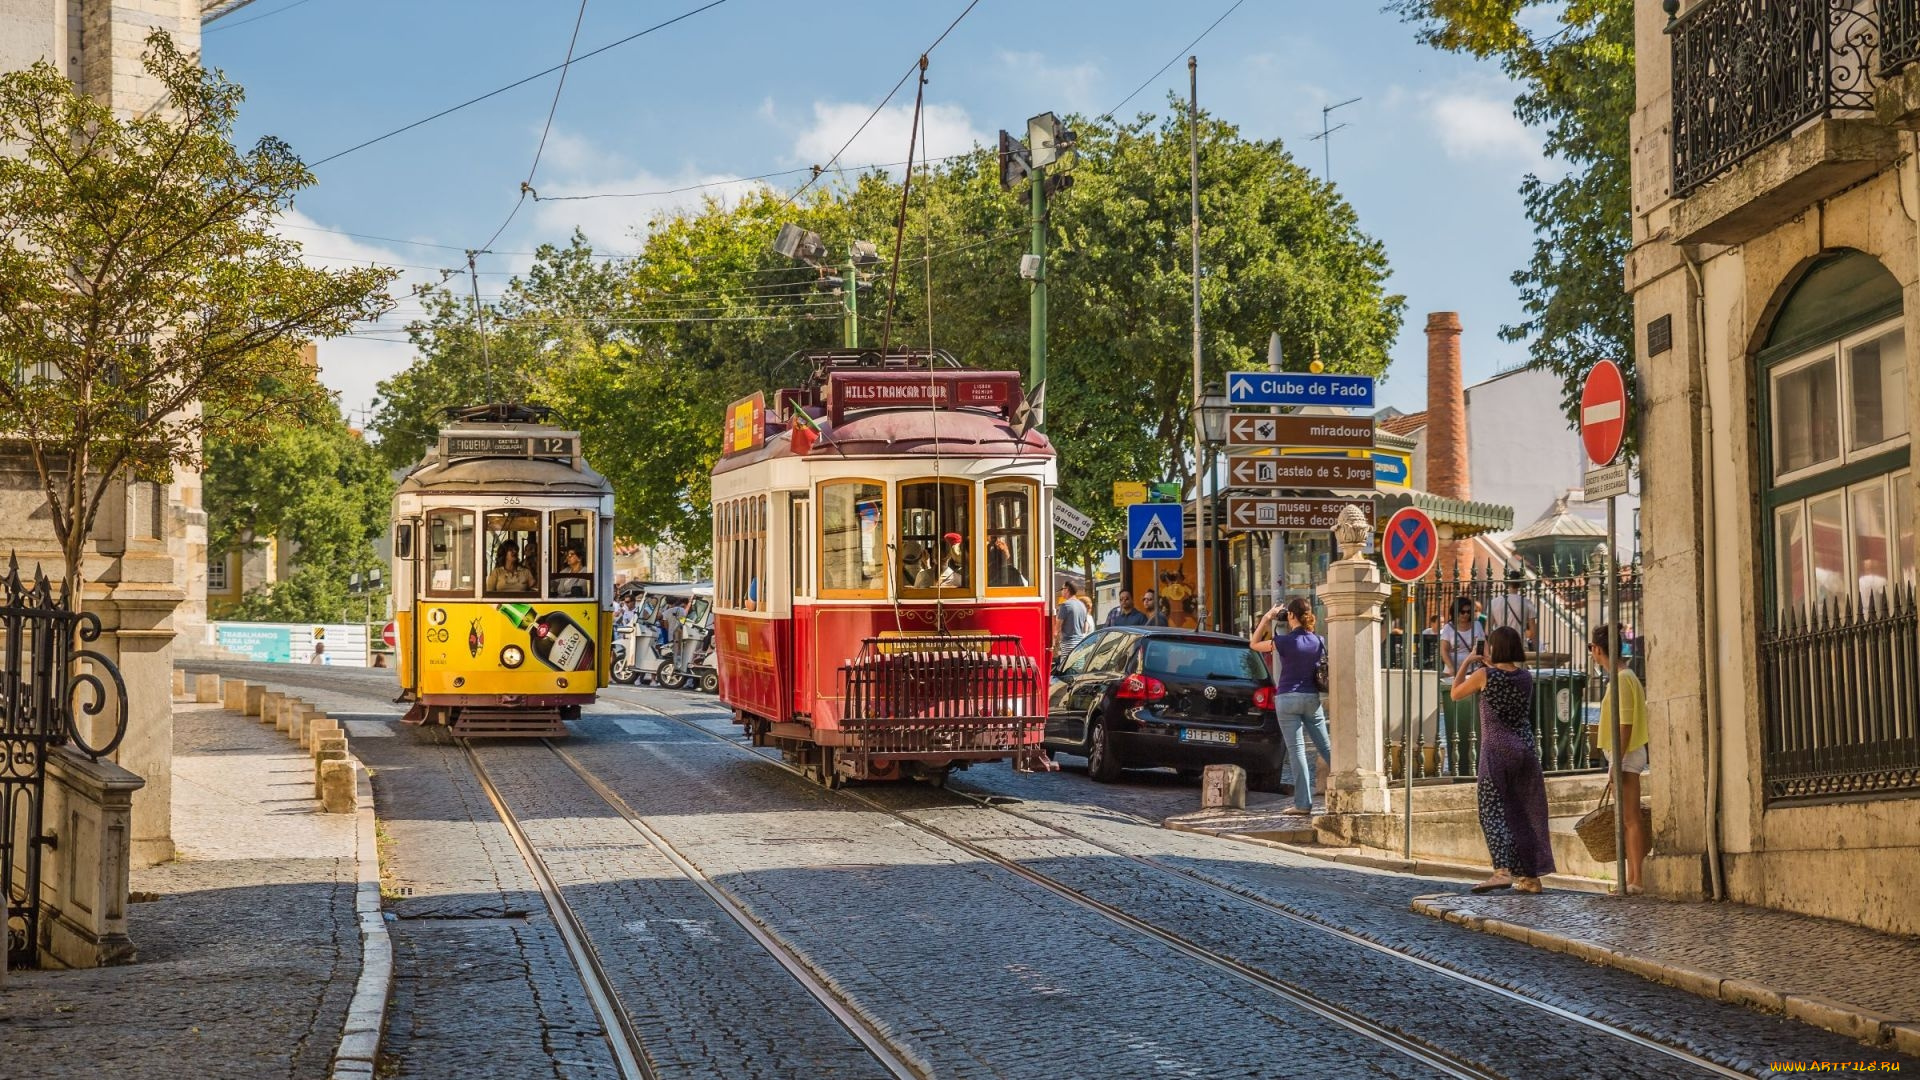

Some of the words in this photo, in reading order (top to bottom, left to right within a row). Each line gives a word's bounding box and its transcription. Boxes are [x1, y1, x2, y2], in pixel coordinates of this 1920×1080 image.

[845, 385, 875, 399] HILLS
[921, 385, 947, 398] TOUR
[1260, 380, 1304, 395] Clube
[1308, 382, 1326, 396] de
[1331, 383, 1367, 397] Fado
[1310, 425, 1371, 438] miradouro
[543, 438, 563, 452] 12
[1277, 465, 1312, 477] castelo
[1317, 466, 1329, 478] de
[1333, 467, 1343, 478] S.
[1347, 467, 1371, 480] Jorge
[503, 496, 521, 505] 565
[1278, 503, 1311, 513] museu
[1321, 502, 1348, 513] esco
[1360, 502, 1371, 514] de
[1055, 504, 1080, 522] parque
[1082, 519, 1091, 528] de
[1278, 515, 1305, 525] artes
[222, 631, 278, 639] TRABALHAMOS
